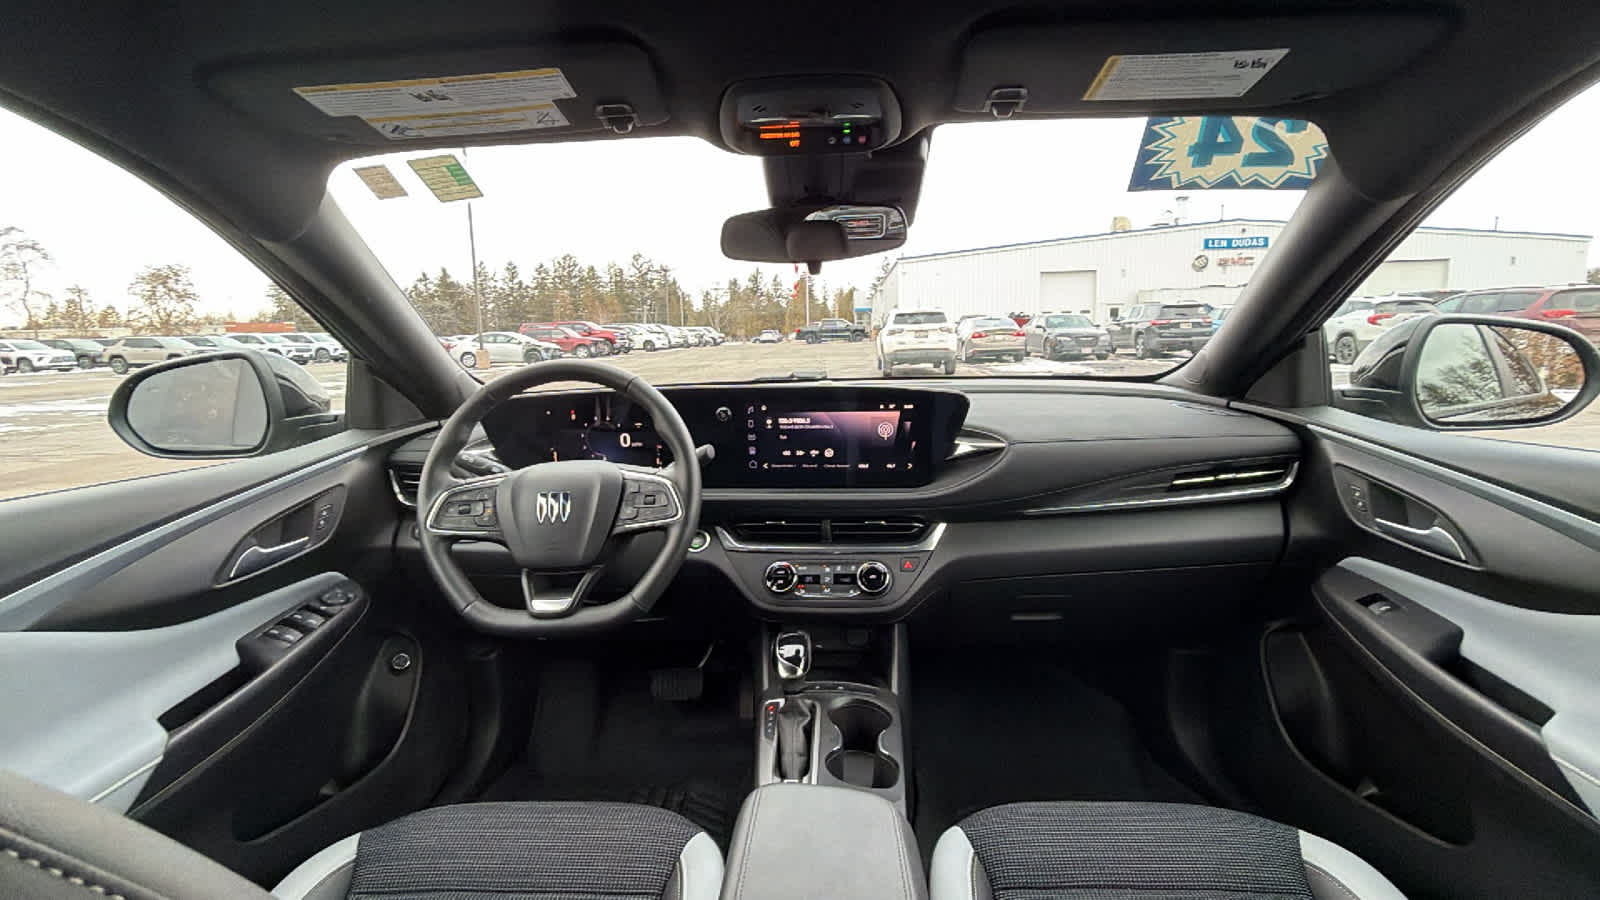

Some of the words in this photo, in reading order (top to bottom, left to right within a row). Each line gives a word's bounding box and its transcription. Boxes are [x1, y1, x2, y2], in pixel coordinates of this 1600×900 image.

[1207, 239, 1227, 248] LEN
[1231, 238, 1265, 248] DUDAS
[619, 432, 631, 448] 0
